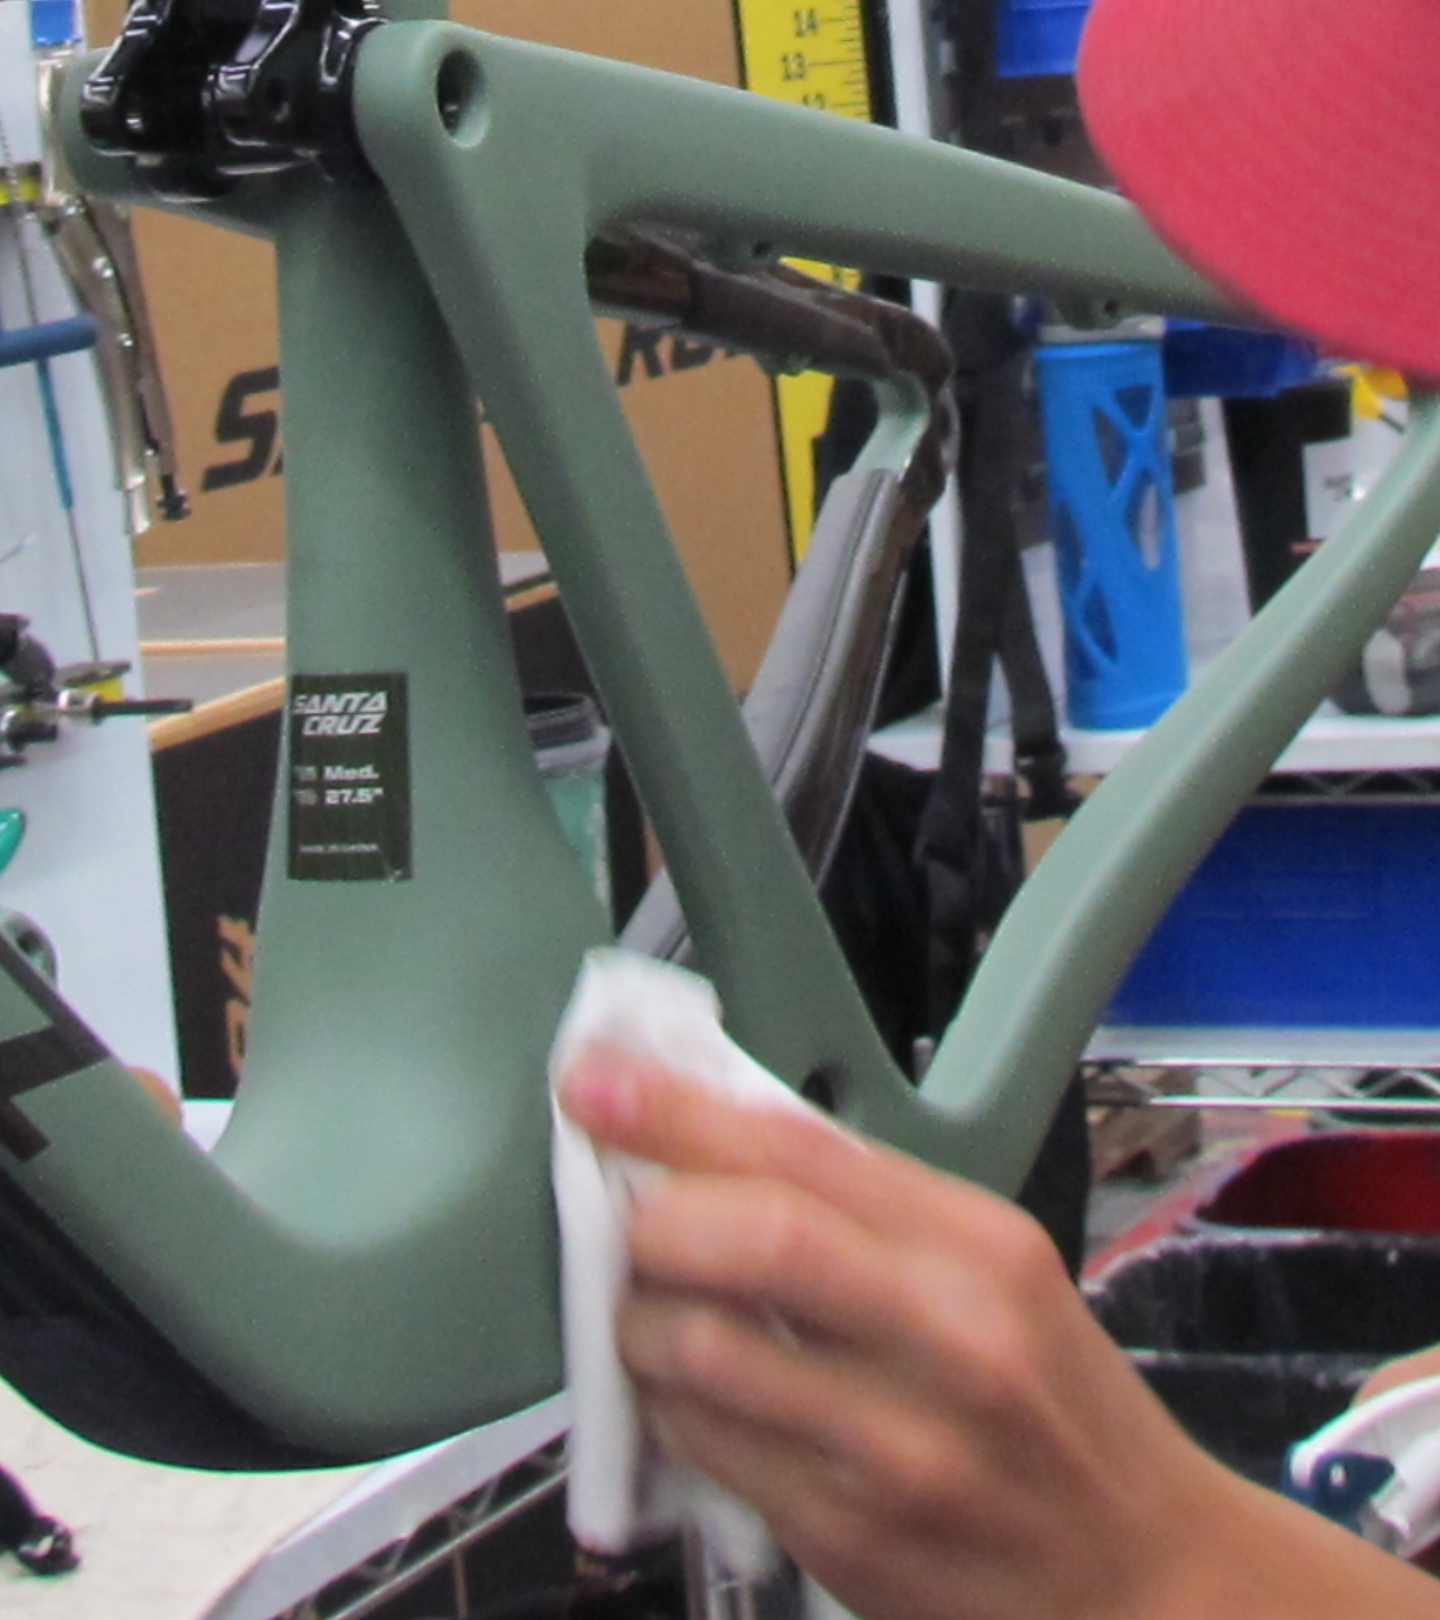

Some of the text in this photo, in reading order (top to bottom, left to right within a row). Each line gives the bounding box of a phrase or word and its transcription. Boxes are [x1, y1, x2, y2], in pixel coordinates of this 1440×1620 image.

[793, 8, 818, 38] 14
[780, 51, 806, 81] 13
[291, 690, 388, 715] SANTA
[302, 713, 385, 736] CRUZ
[323, 764, 379, 781] Med.
